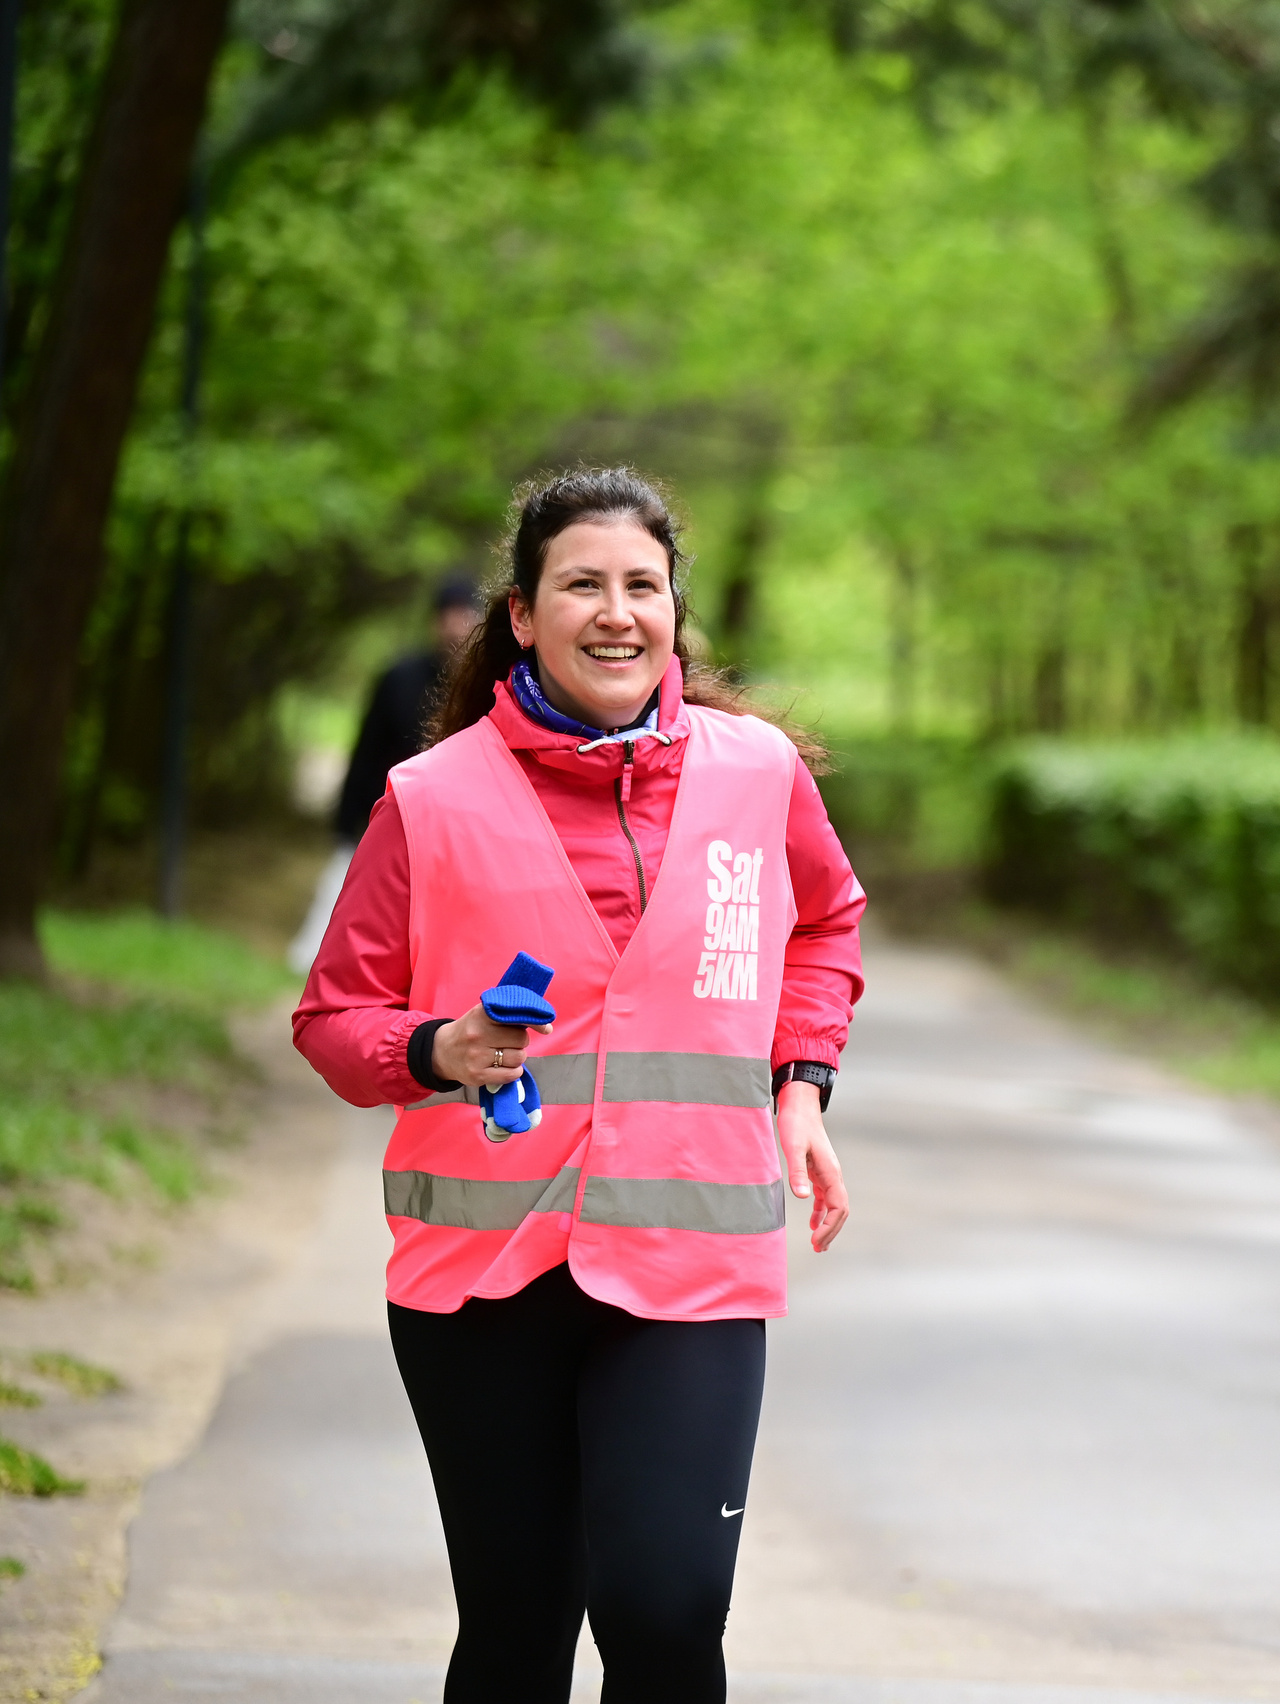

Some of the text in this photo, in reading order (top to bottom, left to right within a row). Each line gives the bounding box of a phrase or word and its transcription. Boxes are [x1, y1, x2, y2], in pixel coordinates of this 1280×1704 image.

[707, 840, 763, 903] Sat
[704, 903, 759, 952] 9AM
[693, 952, 757, 999] 5KM
